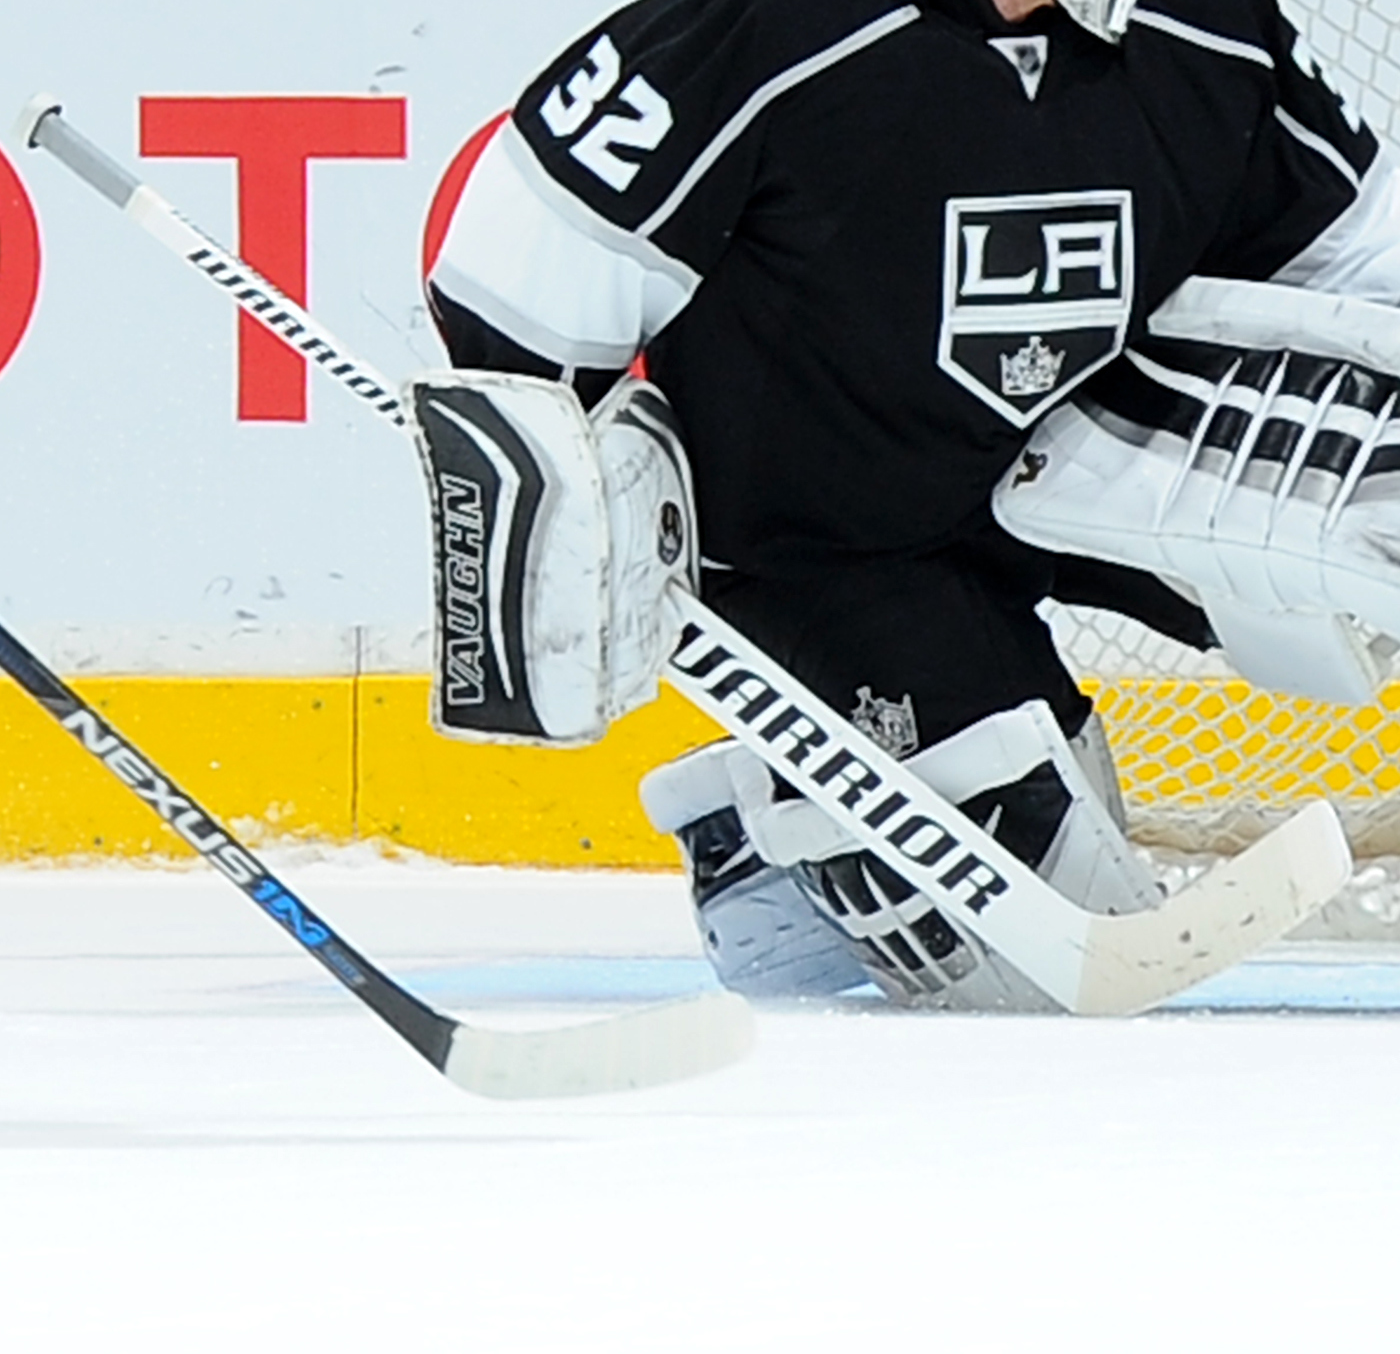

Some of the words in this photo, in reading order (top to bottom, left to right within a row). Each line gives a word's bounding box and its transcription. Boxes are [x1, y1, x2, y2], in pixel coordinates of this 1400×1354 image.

[540, 33, 674, 193] 32
[960, 220, 1120, 297] LA
[440, 472, 485, 705] VAUGHN
[61, 709, 263, 885] NEXUS
